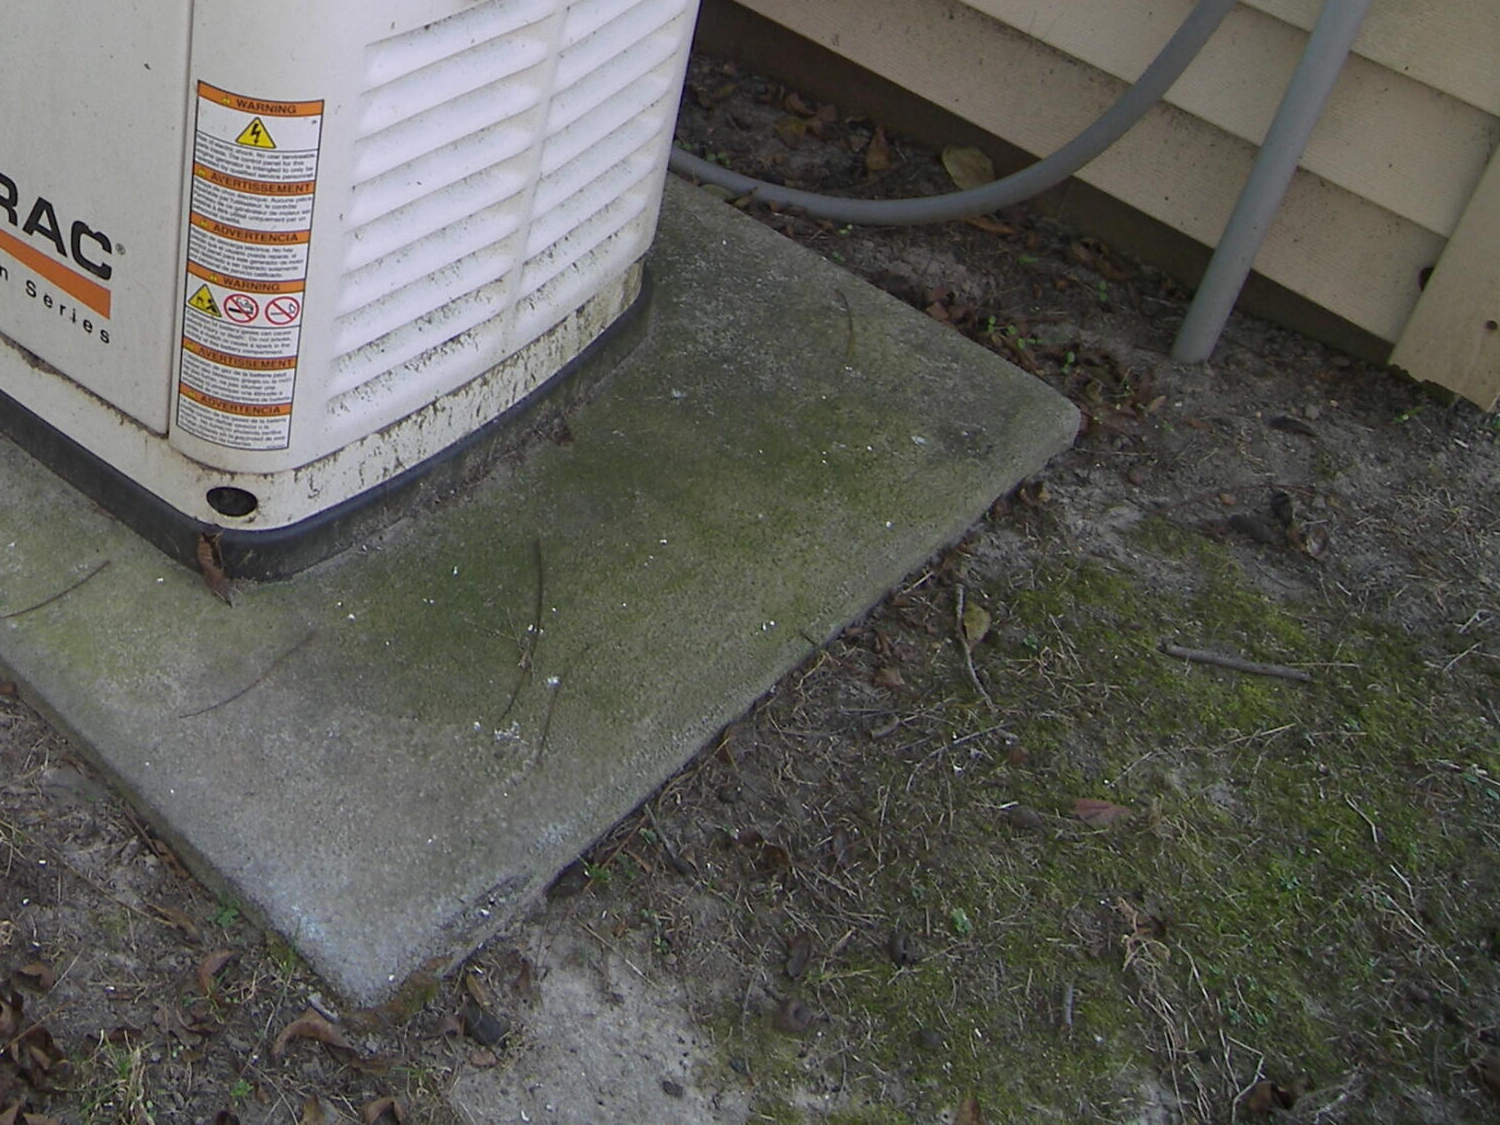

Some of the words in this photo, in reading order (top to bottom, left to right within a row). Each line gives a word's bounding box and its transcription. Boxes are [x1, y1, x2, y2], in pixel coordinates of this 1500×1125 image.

[236, 98, 297, 115] WARNING
[210, 172, 311, 193] AVERTISSEMENT
[212, 225, 299, 242] ADVERTENCIA
[222, 277, 281, 292] WARNING
[25, 279, 111, 344] Series
[198, 348, 294, 368] AVERTISSEMENT
[200, 395, 281, 414] ADVERTENCIA
